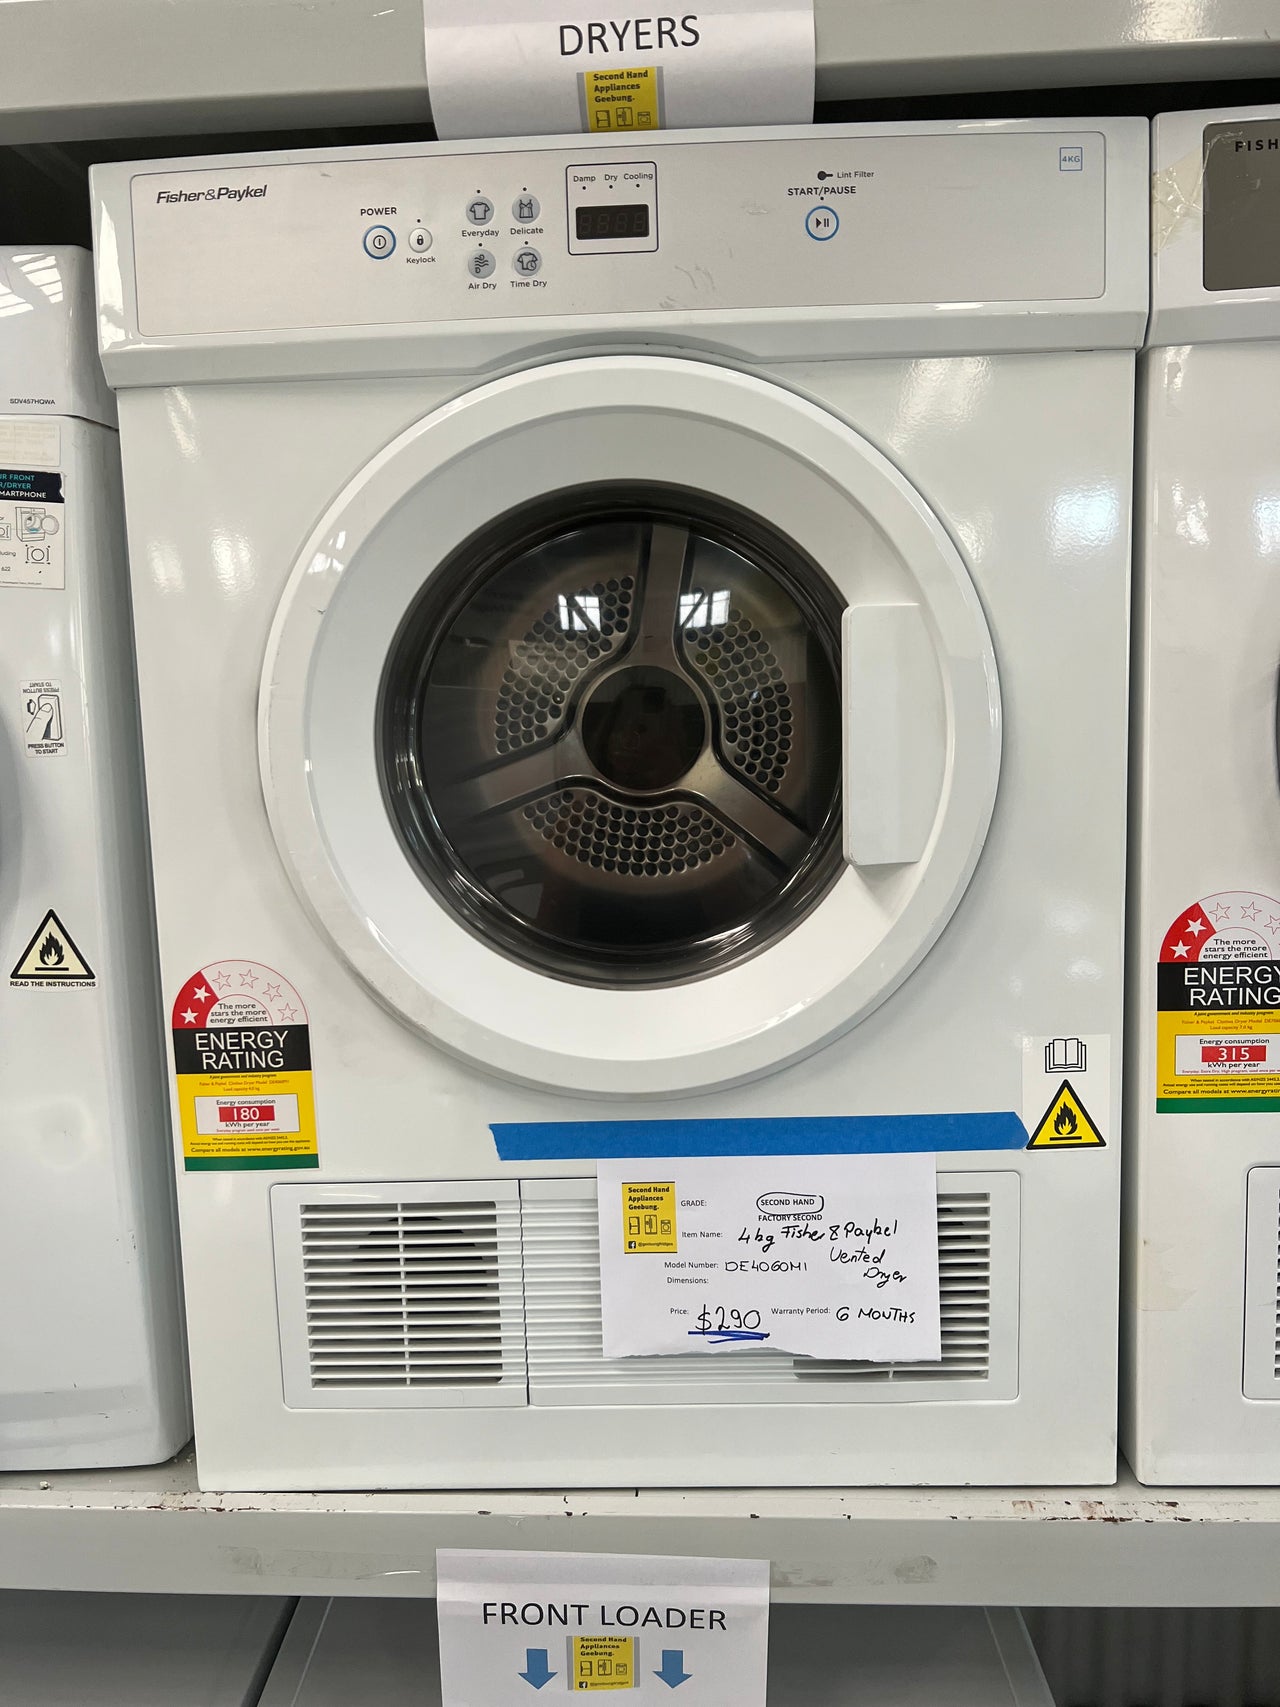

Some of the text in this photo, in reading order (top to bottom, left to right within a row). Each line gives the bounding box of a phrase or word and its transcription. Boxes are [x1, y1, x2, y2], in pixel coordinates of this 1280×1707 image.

[559, 14, 701, 56] DRYERS
[593, 69, 649, 82] Second Hand
[594, 82, 641, 94] Appliances
[594, 93, 636, 104] Geebung.
[1235, 138, 1279, 152] FISH
[1061, 155, 1081, 164] 4KG
[573, 172, 654, 183] Damp Dry Cooling
[836, 169, 875, 179] Lint Filter
[787, 185, 857, 196] START/PAUSE
[360, 206, 397, 217] POWER
[461, 229, 500, 239] Everyday
[510, 226, 544, 236] Delicate
[406, 256, 436, 265] Keylock
[468, 282, 497, 292] Air Dry
[510, 279, 548, 290] Time Dry
[9, 473, 35, 482] FRONT
[1184, 965, 1280, 986] ENERGY
[1190, 987, 1280, 1006] RATING
[218, 1002, 233, 1010] The
[210, 1015, 268, 1025] energy efficient
[195, 1030, 289, 1051] ENERGY
[1199, 1038, 1223, 1046] Energy
[1218, 1047, 1250, 1060] 315
[202, 1050, 285, 1070] RATING
[216, 1099, 236, 1107] Energy
[233, 1107, 260, 1120] 180
[628, 1195, 664, 1203] Appliances
[761, 1198, 790, 1206] SECOND
[793, 1198, 815, 1206] HAND
[758, 1214, 823, 1222] FACTORY SECOND
[700, 1231, 723, 1239] Name:
[780, 1223, 826, 1242] Fisher
[844, 1218, 898, 1245] Paykel
[830, 1246, 886, 1265] Vented
[664, 1261, 685, 1269] Model
[687, 1261, 719, 1269] Number:
[667, 1276, 709, 1284] Dimensions:
[863, 1267, 907, 1288] Dryer
[670, 1303, 916, 1335] Price: $290 Warranty Period: 6 MONTHS
[482, 1602, 728, 1631] FRONT LOADER
